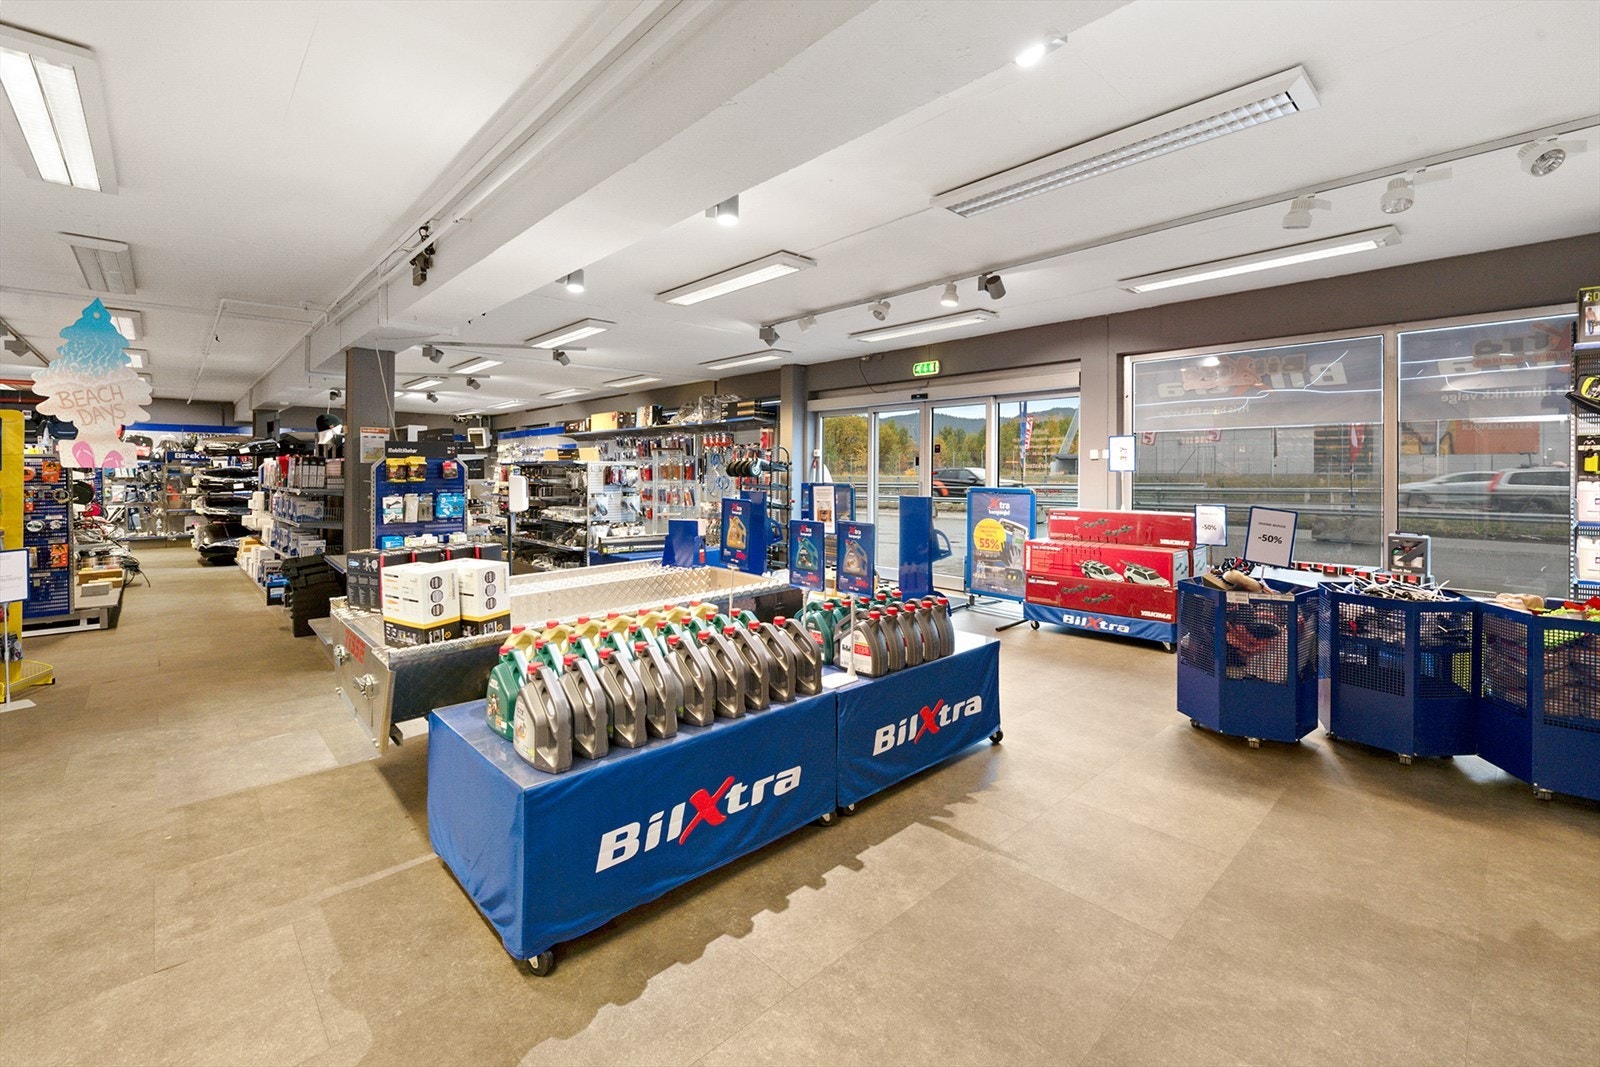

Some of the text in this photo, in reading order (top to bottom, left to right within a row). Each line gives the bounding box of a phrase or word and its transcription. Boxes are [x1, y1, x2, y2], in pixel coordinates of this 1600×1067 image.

[55, 385, 125, 409] BEACH
[77, 403, 127, 427] DAYS
[987, 498, 1011, 510] Xtra
[979, 537, 1000, 550] 55%
[1159, 538, 1190, 547] YAKIMA
[1258, 534, 1283, 545] -50%
[1140, 610, 1172, 620] YAKIMA
[1063, 614, 1130, 633] BilXtra
[873, 695, 983, 757] BilXtra
[595, 765, 802, 873] BilXtra
